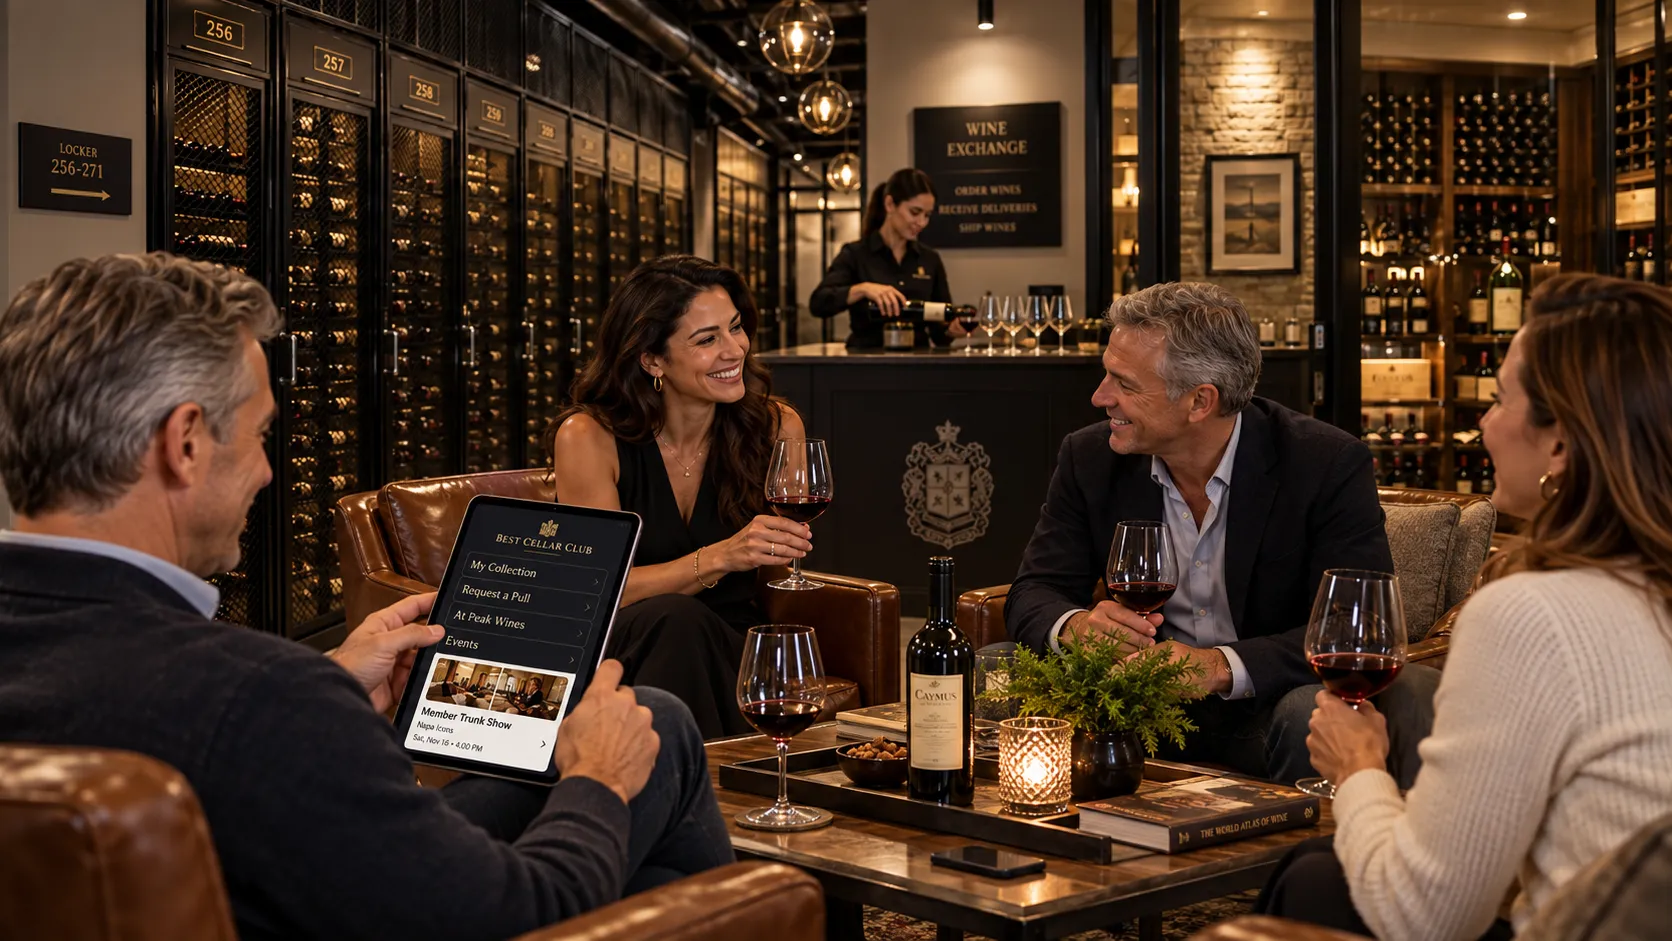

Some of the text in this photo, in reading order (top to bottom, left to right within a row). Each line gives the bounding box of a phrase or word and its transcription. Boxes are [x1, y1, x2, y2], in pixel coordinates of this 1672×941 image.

[206, 19, 233, 42] 256
[323, 53, 345, 73] 257
[415, 81, 433, 100] 258
[966, 121, 1008, 136] WINE
[59, 142, 98, 158] LOCKER
[947, 140, 1028, 157] EXCHANGE
[51, 158, 104, 179] 256-271
[954, 184, 1021, 196] ORDER WINES
[938, 202, 1038, 215] RECEIVE DELIVERIES
[959, 221, 1016, 233] SHIP WINES
[495, 533, 593, 555] BEST CELLAR CLUB
[470, 560, 537, 579] My Collection
[462, 584, 501, 600] Request
[511, 592, 531, 604] Pull
[453, 610, 526, 630] At Peak Wines
[445, 635, 479, 650] Events
[914, 688, 957, 701] CAYMUS
[416, 720, 454, 734] Napa Icons
[421, 706, 513, 730] Member Trunk Show
[412, 733, 425, 743] Sat,
[426, 736, 440, 745] Nov
[471, 743, 483, 752] PM
[1200, 812, 1288, 838] THE WORLD ATLAS OF WINE
